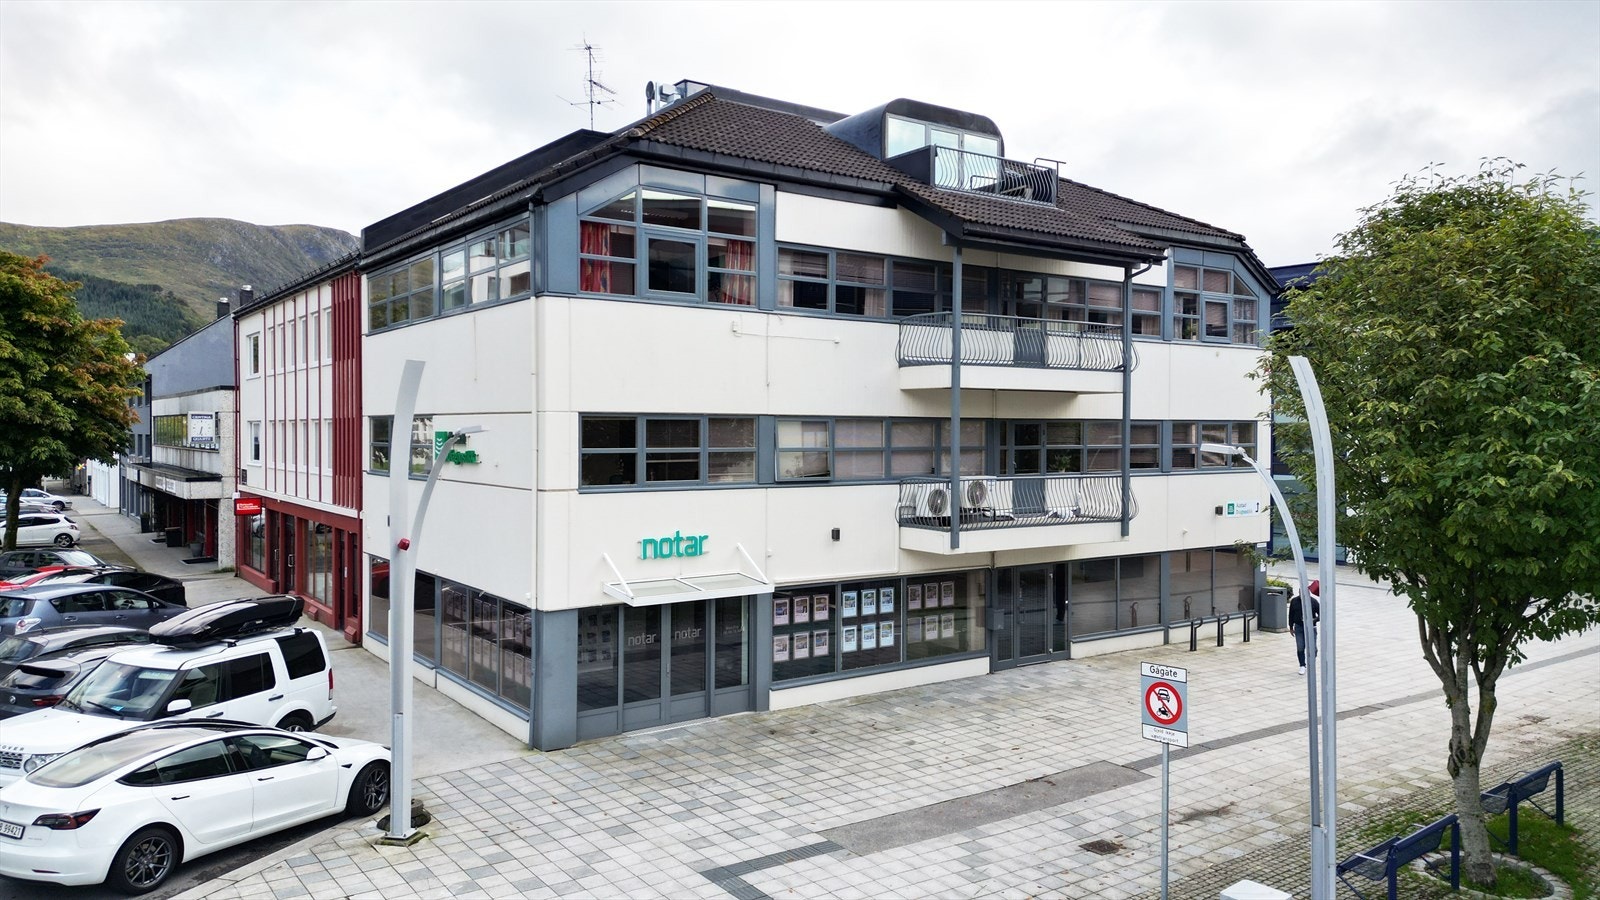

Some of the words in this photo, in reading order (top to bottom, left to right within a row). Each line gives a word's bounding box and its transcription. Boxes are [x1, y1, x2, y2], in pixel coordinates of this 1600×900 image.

[641, 530, 709, 560] notar
[627, 632, 657, 647] notar
[674, 627, 702, 641] notar
[1149, 665, 1178, 677] Gågate
